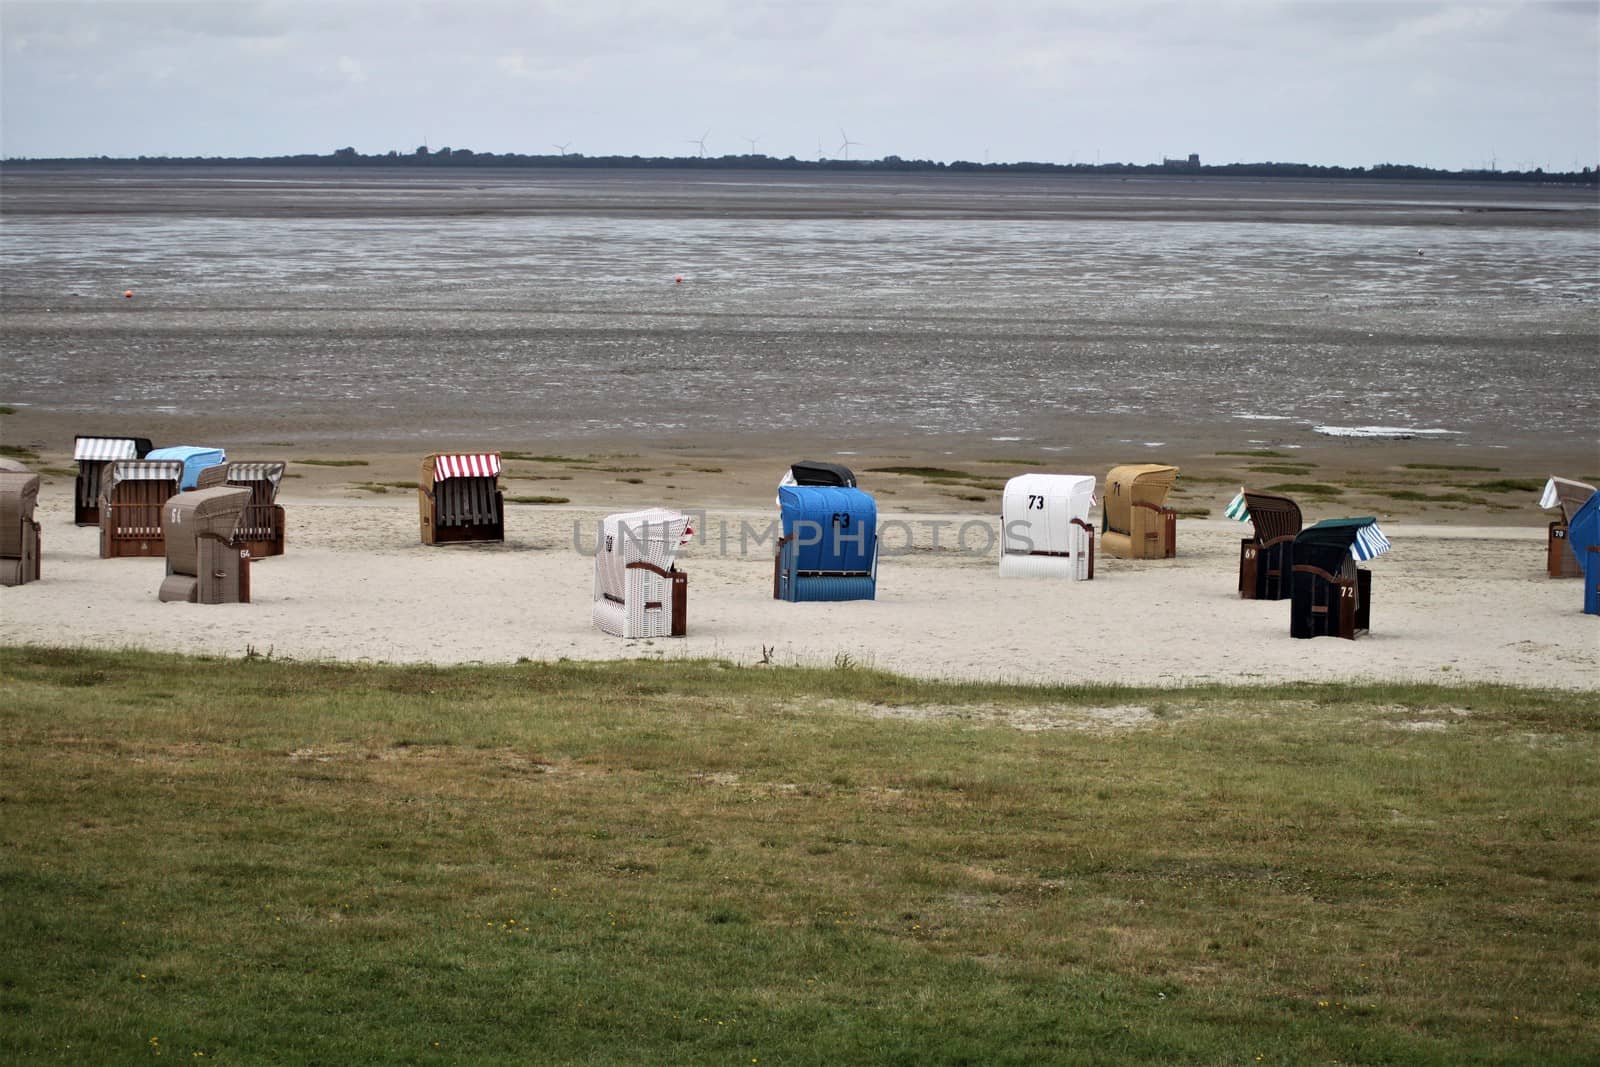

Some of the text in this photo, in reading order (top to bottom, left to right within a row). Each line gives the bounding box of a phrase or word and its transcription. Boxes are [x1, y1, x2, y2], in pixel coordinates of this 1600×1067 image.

[1028, 494, 1045, 510] 73
[1245, 549, 1256, 559] 69
[1341, 586, 1353, 598] 72
